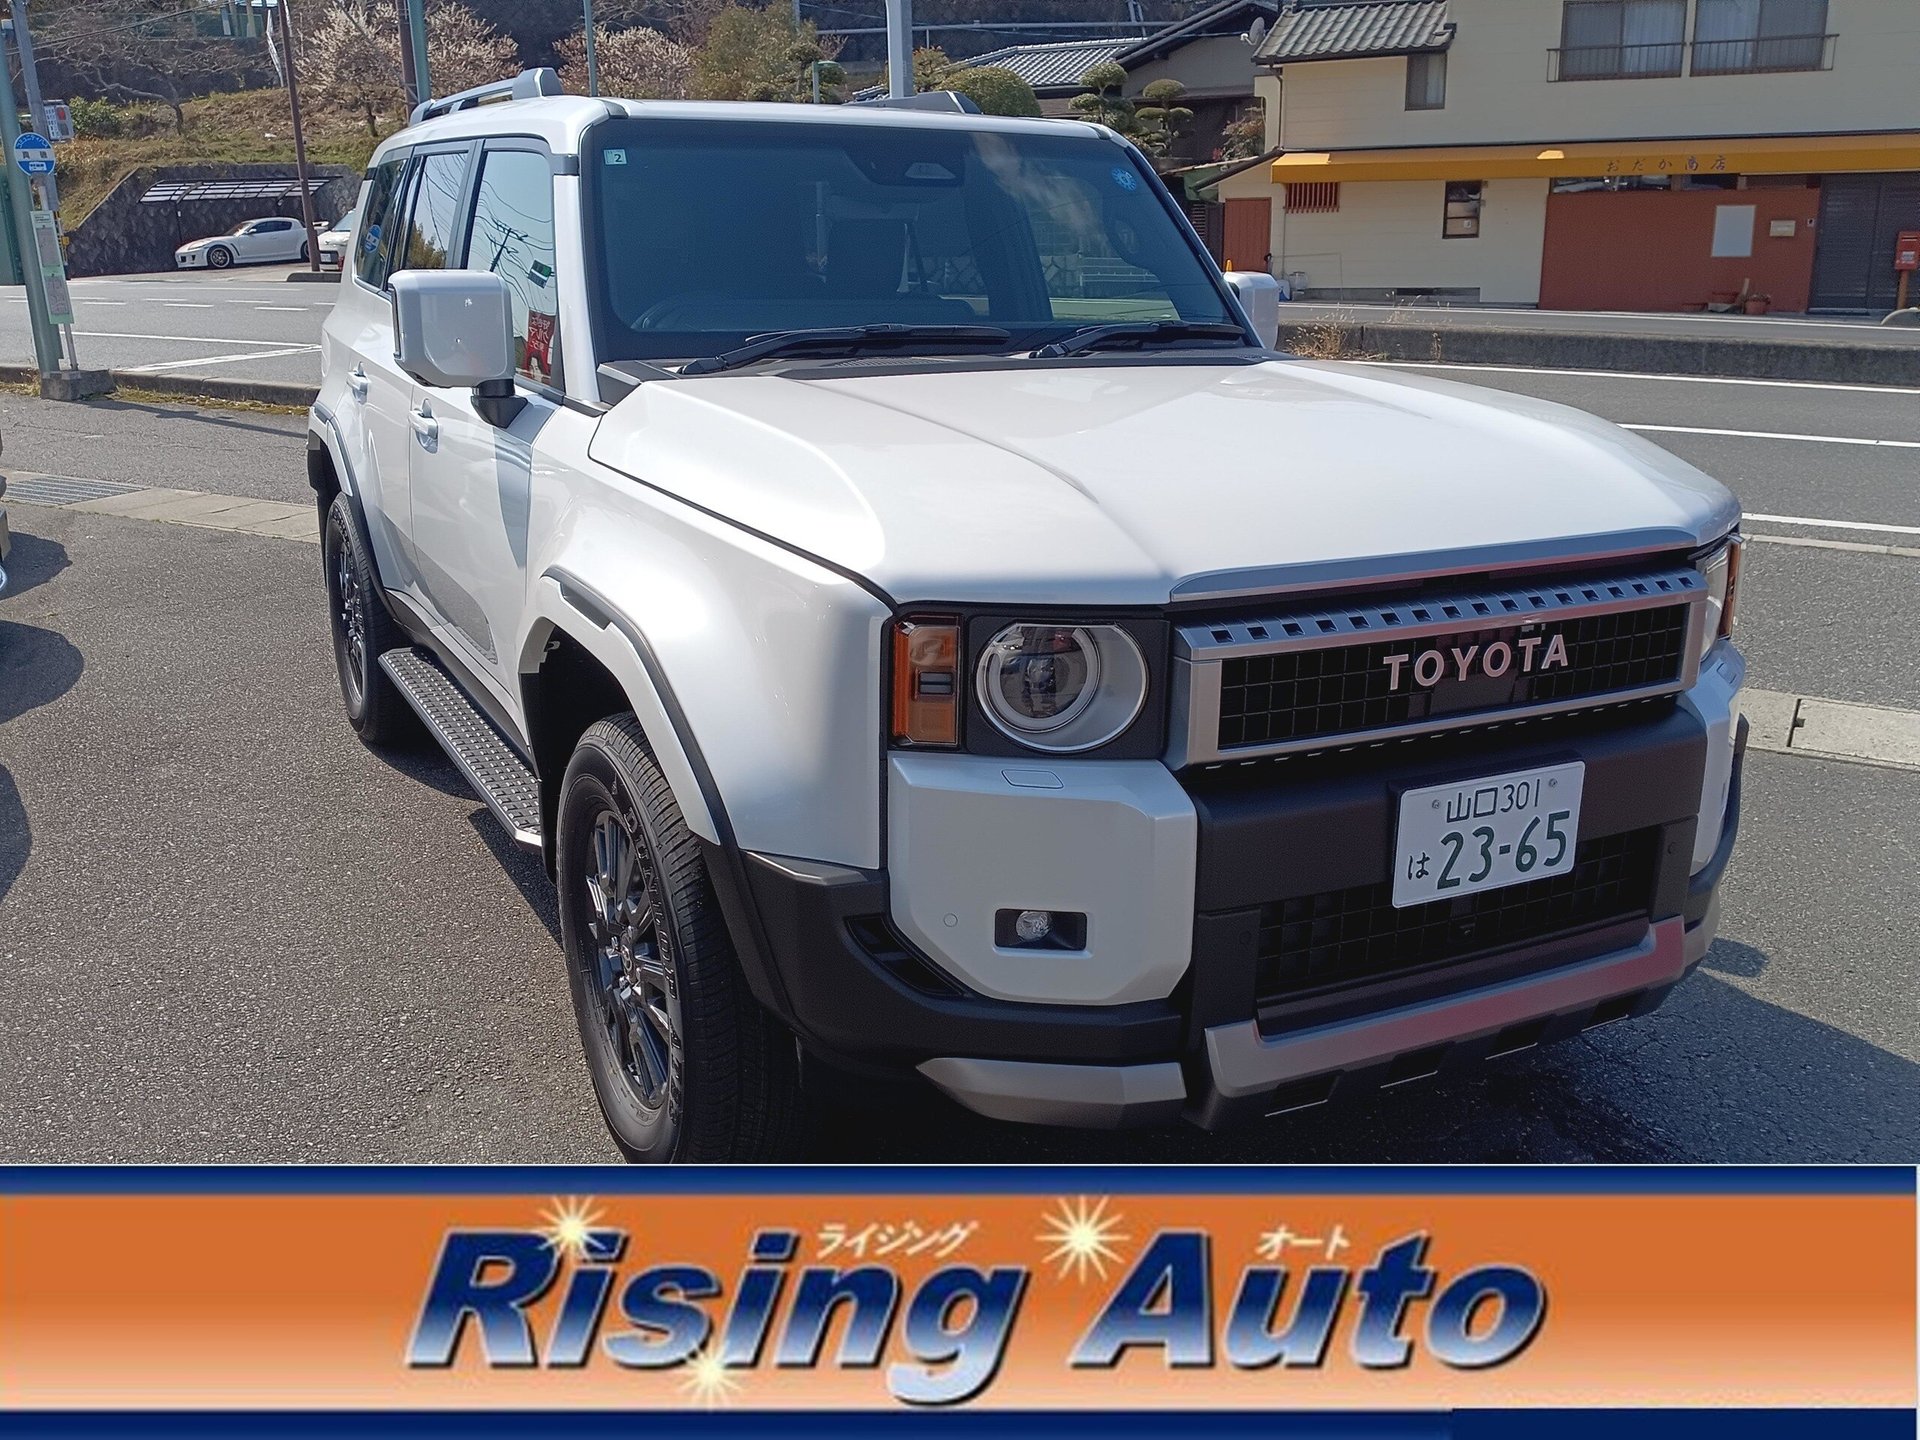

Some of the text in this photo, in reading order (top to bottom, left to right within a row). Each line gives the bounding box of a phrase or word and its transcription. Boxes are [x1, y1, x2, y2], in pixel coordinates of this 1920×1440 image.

[1607, 155, 1726, 172] おだか商店
[1383, 634, 1568, 691] TOYOTA
[1437, 810, 1570, 890] 23-65
